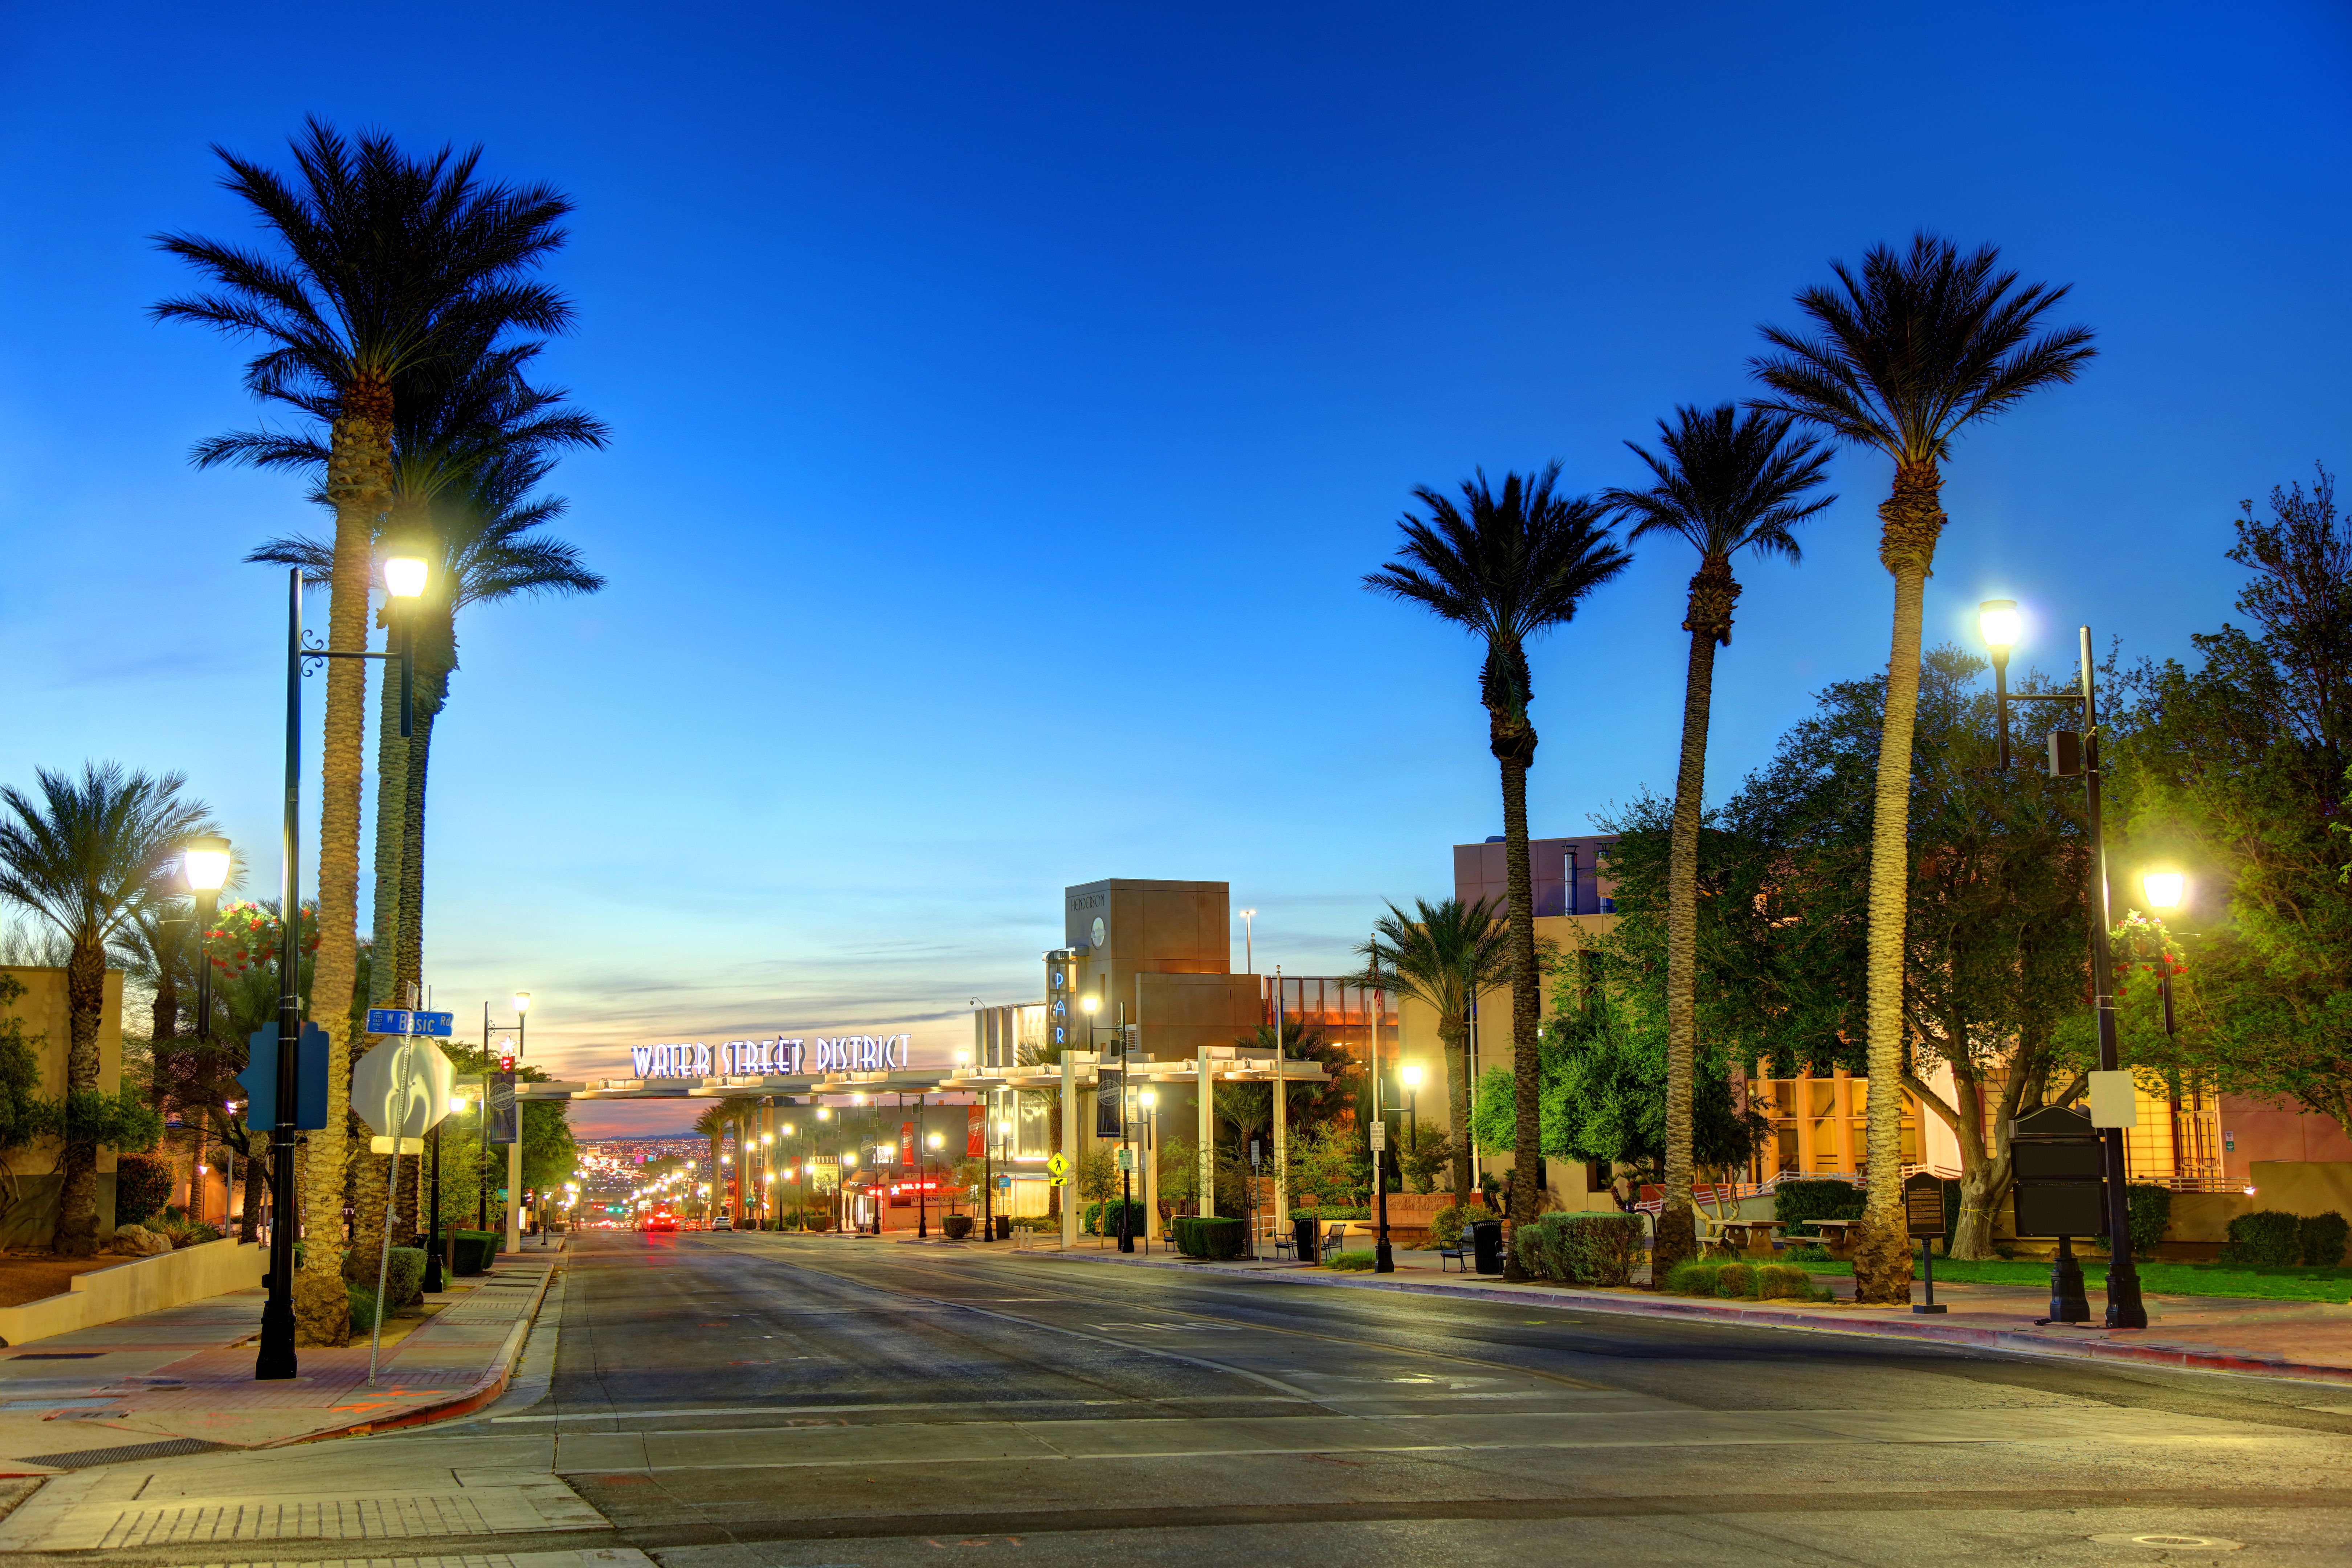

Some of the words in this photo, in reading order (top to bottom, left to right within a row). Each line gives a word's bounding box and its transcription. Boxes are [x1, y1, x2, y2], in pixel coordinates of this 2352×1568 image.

[1071, 894, 1104, 912] HENDERSON
[387, 1013, 394, 1023] W
[399, 1013, 435, 1032] Basic
[440, 1015, 451, 1026] Rd
[633, 1041, 710, 1076] WATER
[721, 1039, 804, 1074] STREET
[817, 1034, 911, 1071] DISTRICT
[491, 1092, 514, 1103] Henderson
[1098, 1089, 1120, 1098] Henderson
